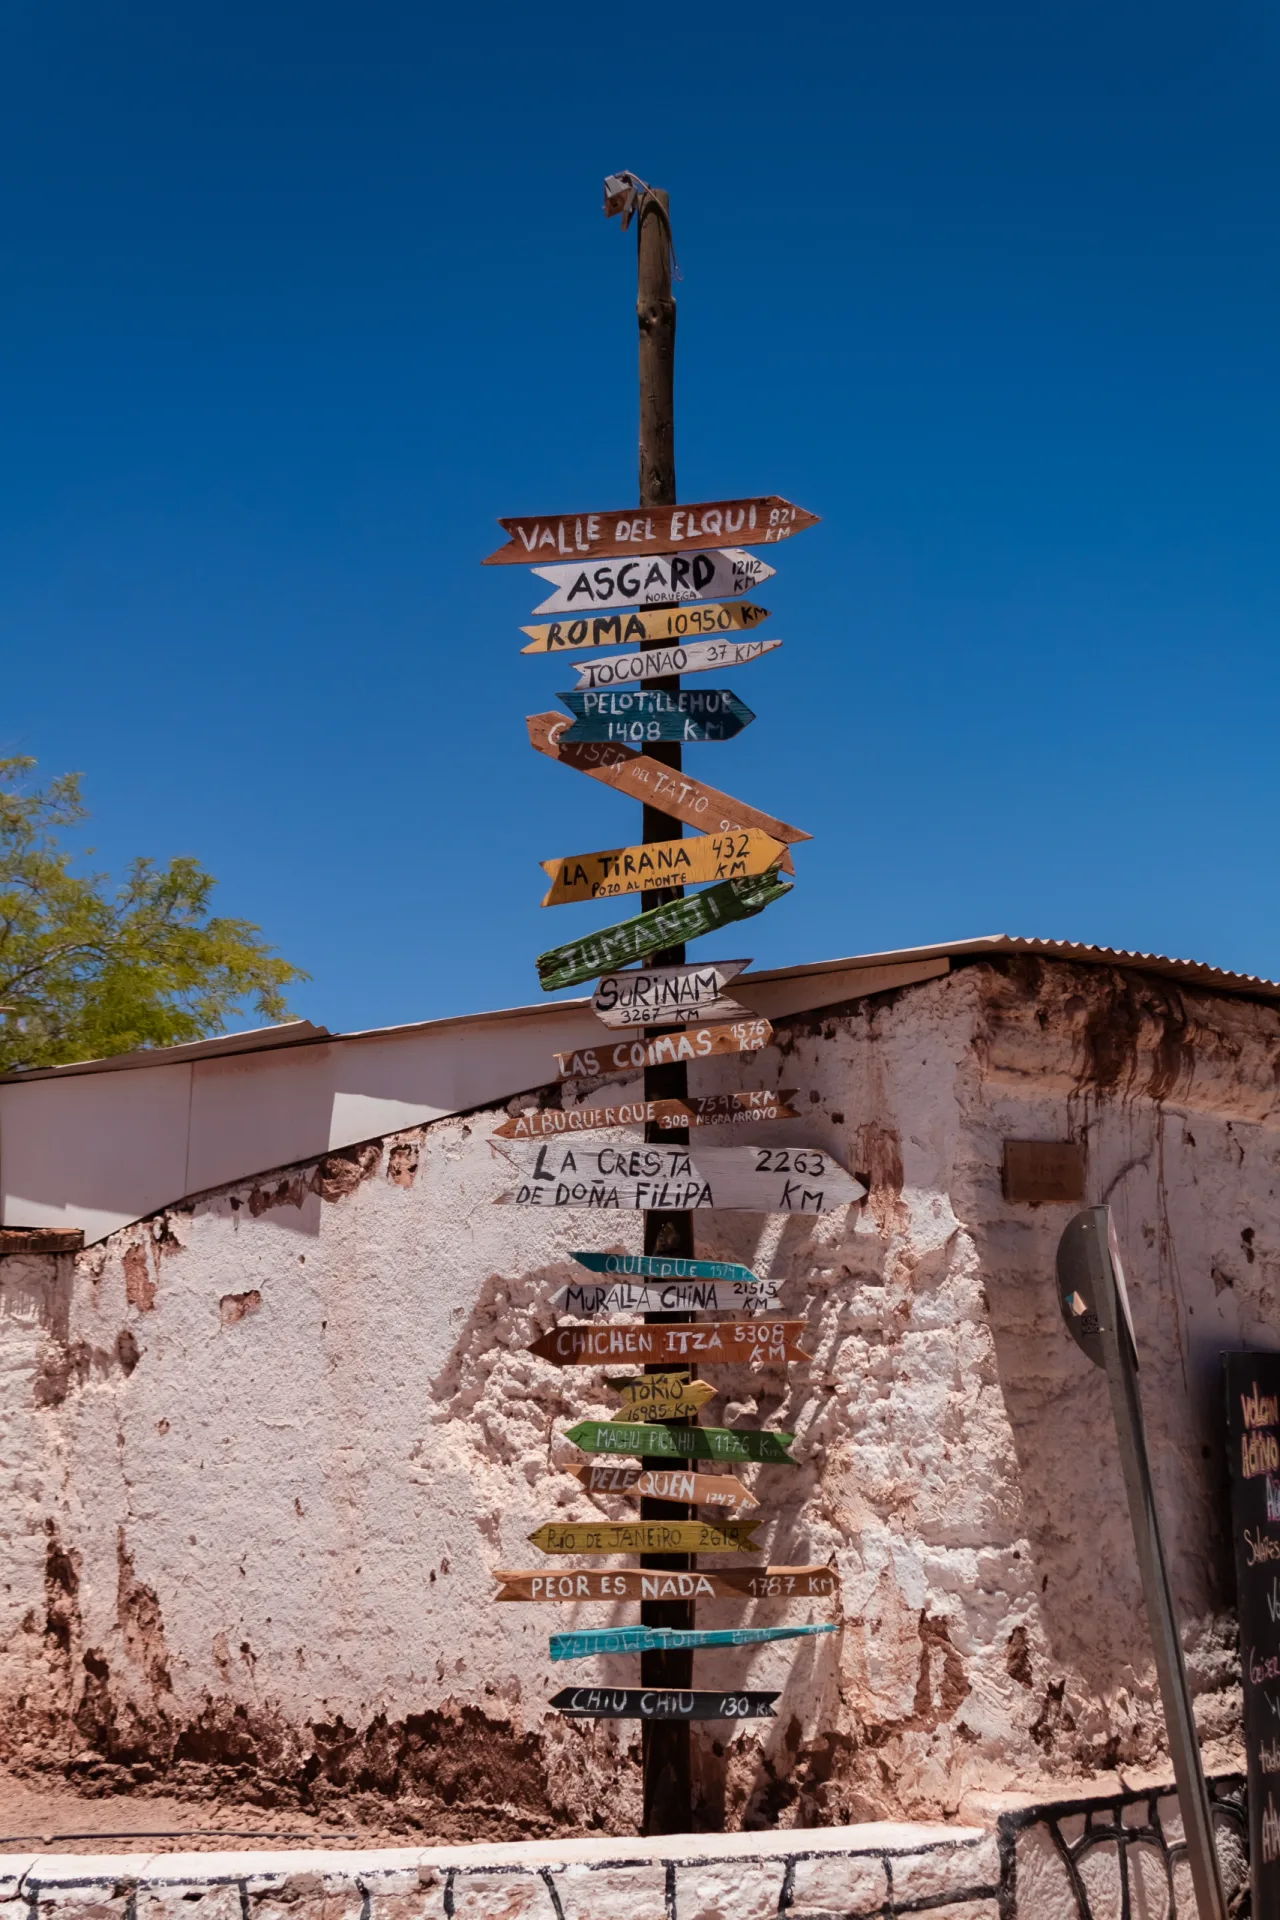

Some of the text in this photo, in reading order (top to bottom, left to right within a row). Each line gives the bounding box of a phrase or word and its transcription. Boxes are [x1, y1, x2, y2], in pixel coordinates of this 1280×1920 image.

[769, 508, 796, 526] 821
[518, 504, 757, 554] VALLE DEL ELQUI
[764, 526, 791, 542] KM
[566, 554, 716, 602] ASGARD
[733, 576, 759, 592] KM
[547, 606, 768, 650] ROMA 10950 KM
[583, 641, 764, 688] TOCONAO 37 KM
[608, 721, 661, 742] 1408
[632, 765, 649, 783] DEL
[712, 834, 750, 859] 432
[563, 864, 588, 886] LA
[715, 859, 747, 879] KM
[592, 872, 687, 897] POZO AL MONTE
[557, 896, 721, 979] JUMANJI
[621, 1008, 699, 1024] 3267 KM
[730, 1022, 766, 1039] 1576
[739, 1037, 765, 1051] KM
[558, 1049, 600, 1078] LAS
[698, 1091, 779, 1113] 7596 KM
[514, 1102, 655, 1137] ALBUQUERQUE
[661, 1114, 689, 1129] 308
[532, 1144, 693, 1181] LA CRESTA
[755, 1149, 826, 1177] 2263
[516, 1184, 543, 1205] DE
[555, 1179, 619, 1208] DOÑA
[733, 1281, 777, 1296] 21515
[742, 1296, 768, 1310] KM
[733, 1324, 785, 1344] 5308
[749, 1344, 786, 1362] KM
[627, 1402, 697, 1421] 16985 KM
[596, 1428, 640, 1450] MACHU
[649, 1434, 696, 1452] PICCHU
[715, 1435, 750, 1453] 1176
[586, 1533, 602, 1548] DE
[532, 1575, 835, 1599] PEOR ES NADA 1787 KM
[557, 1631, 708, 1660] YELLOWSTONE
[719, 1697, 749, 1716] 130
